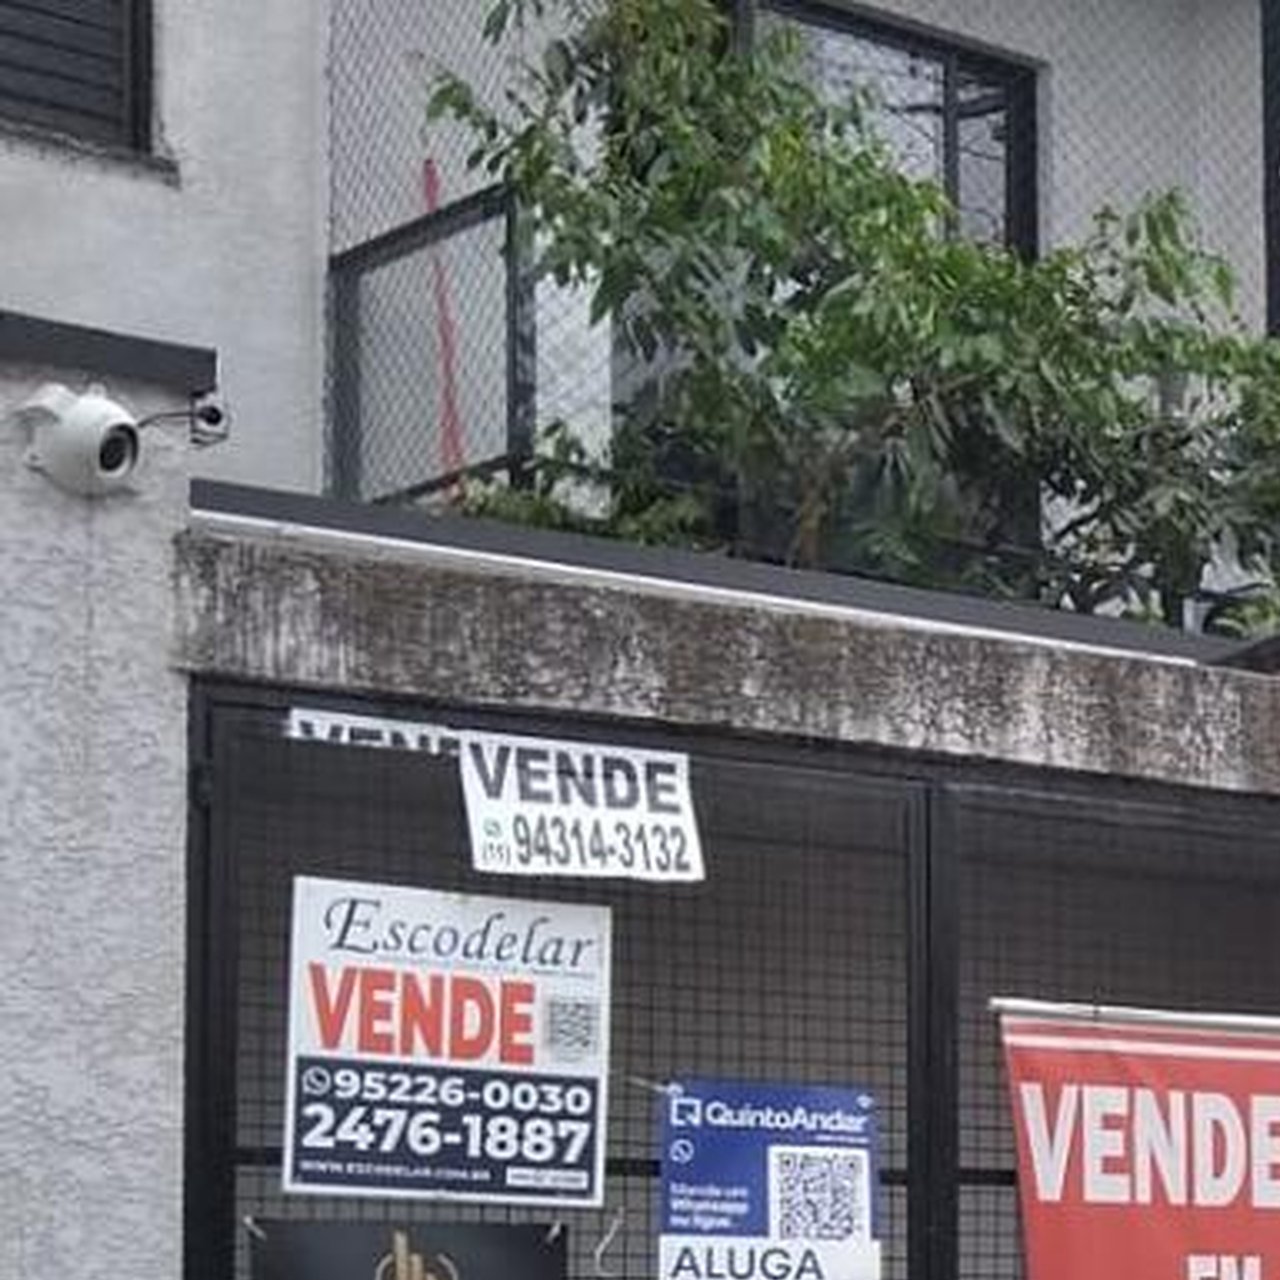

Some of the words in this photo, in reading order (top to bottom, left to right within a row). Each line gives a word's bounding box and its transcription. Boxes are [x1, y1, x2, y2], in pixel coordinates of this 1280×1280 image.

[470, 742, 681, 814] VENDE
[513, 814, 691, 872] 94314-3132
[324, 897, 593, 969] Escodelar
[308, 962, 536, 1064] VENDE
[332, 1069, 591, 1115] 95226-0030
[705, 1101, 868, 1132] QuintoAndar
[301, 1104, 591, 1163] 2476-1887
[670, 1248, 824, 1280] ALUGA
